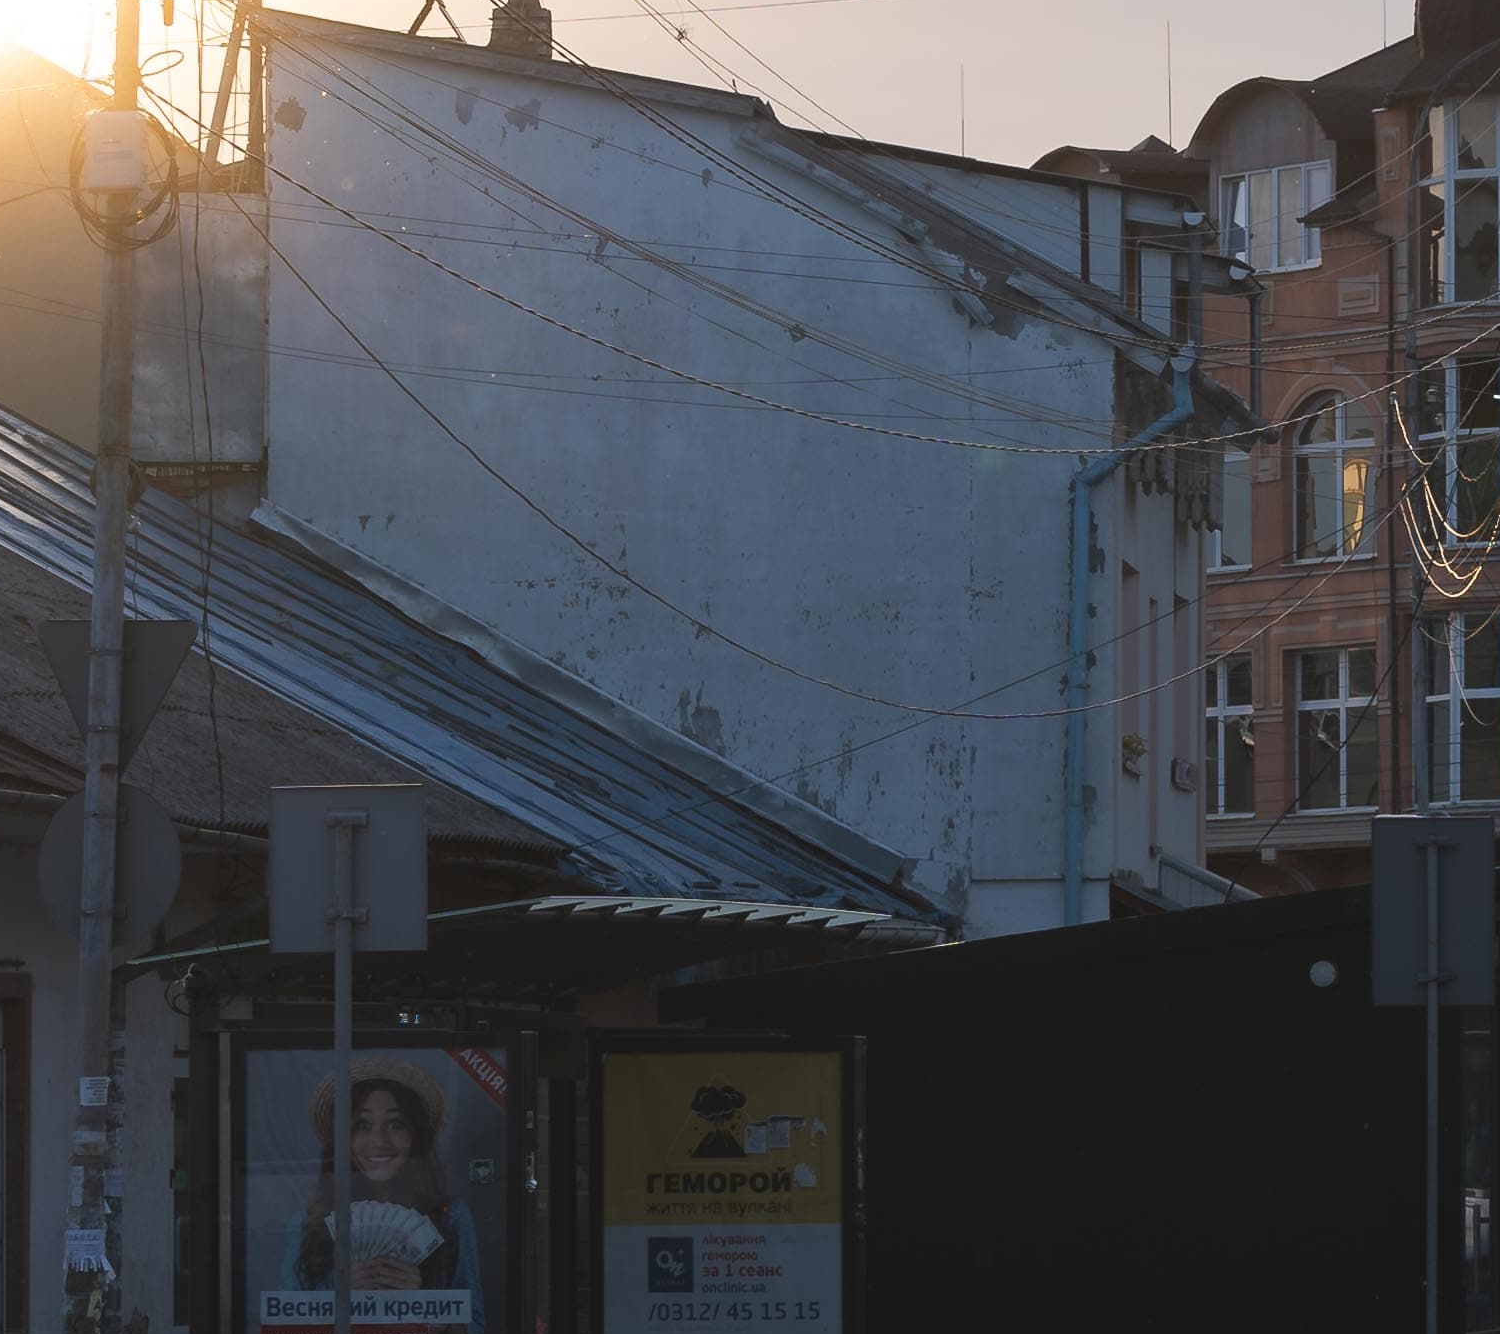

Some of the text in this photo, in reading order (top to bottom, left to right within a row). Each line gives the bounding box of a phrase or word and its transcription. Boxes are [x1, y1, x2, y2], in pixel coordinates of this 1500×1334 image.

[459, 1047, 511, 1096] АКЦІЯ!
[645, 1166, 792, 1193] ГЕМОРОЙ
[646, 1201, 792, 1217] життя на вулкані
[702, 1234, 766, 1247] лікування
[702, 1253, 758, 1263] геморою
[702, 1265, 782, 1277] за 1 сеанс
[702, 1282, 766, 1294] onclinic.ua
[267, 1296, 463, 1320] Весняий кредит
[648, 1302, 820, 1321] /0312/ 45 15 15
